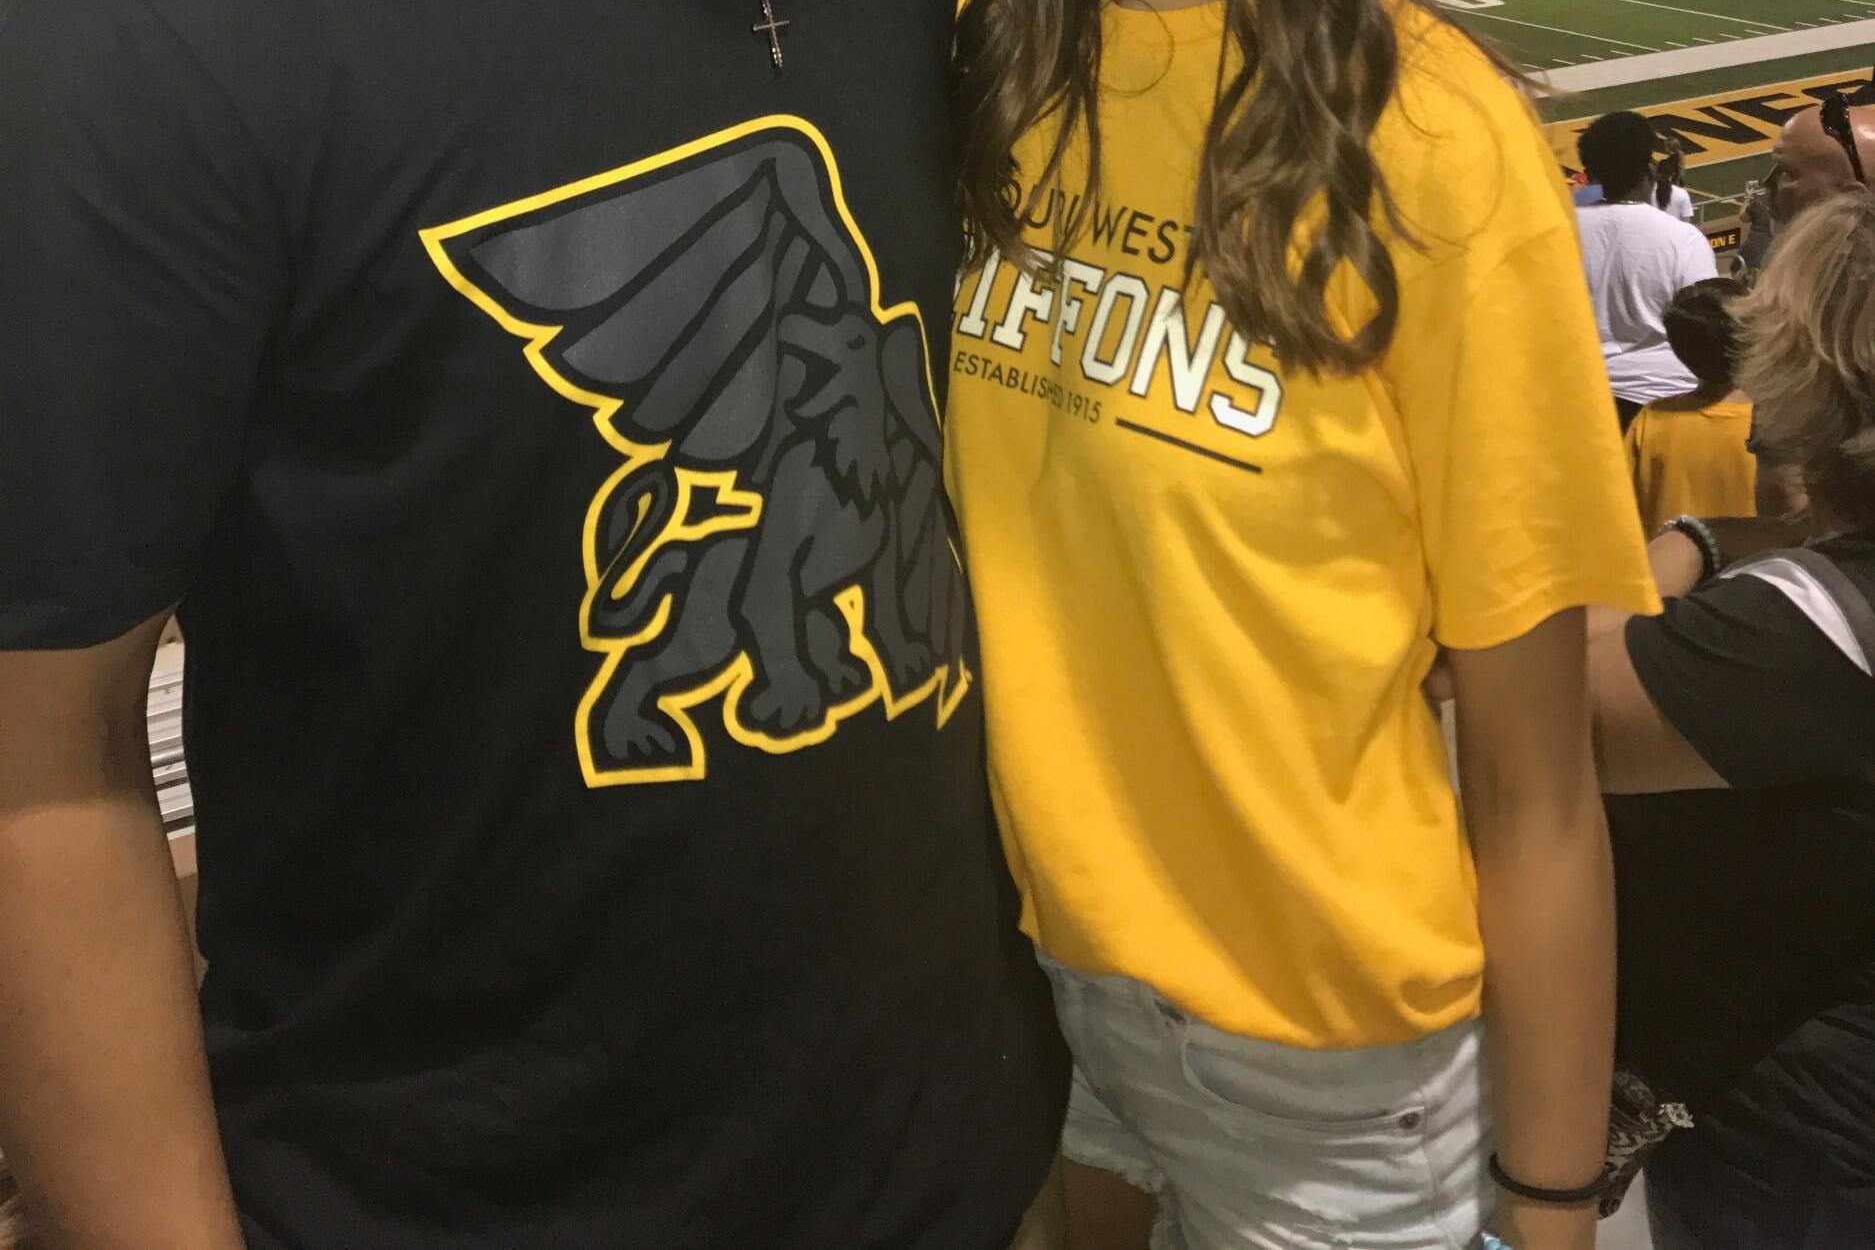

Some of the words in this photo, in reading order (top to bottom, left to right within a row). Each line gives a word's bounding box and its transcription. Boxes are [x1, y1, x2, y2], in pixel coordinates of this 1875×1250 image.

[1728, 234, 1736, 245] E
[950, 246, 1283, 438] IFFONS
[1066, 390, 1102, 423] 1915
